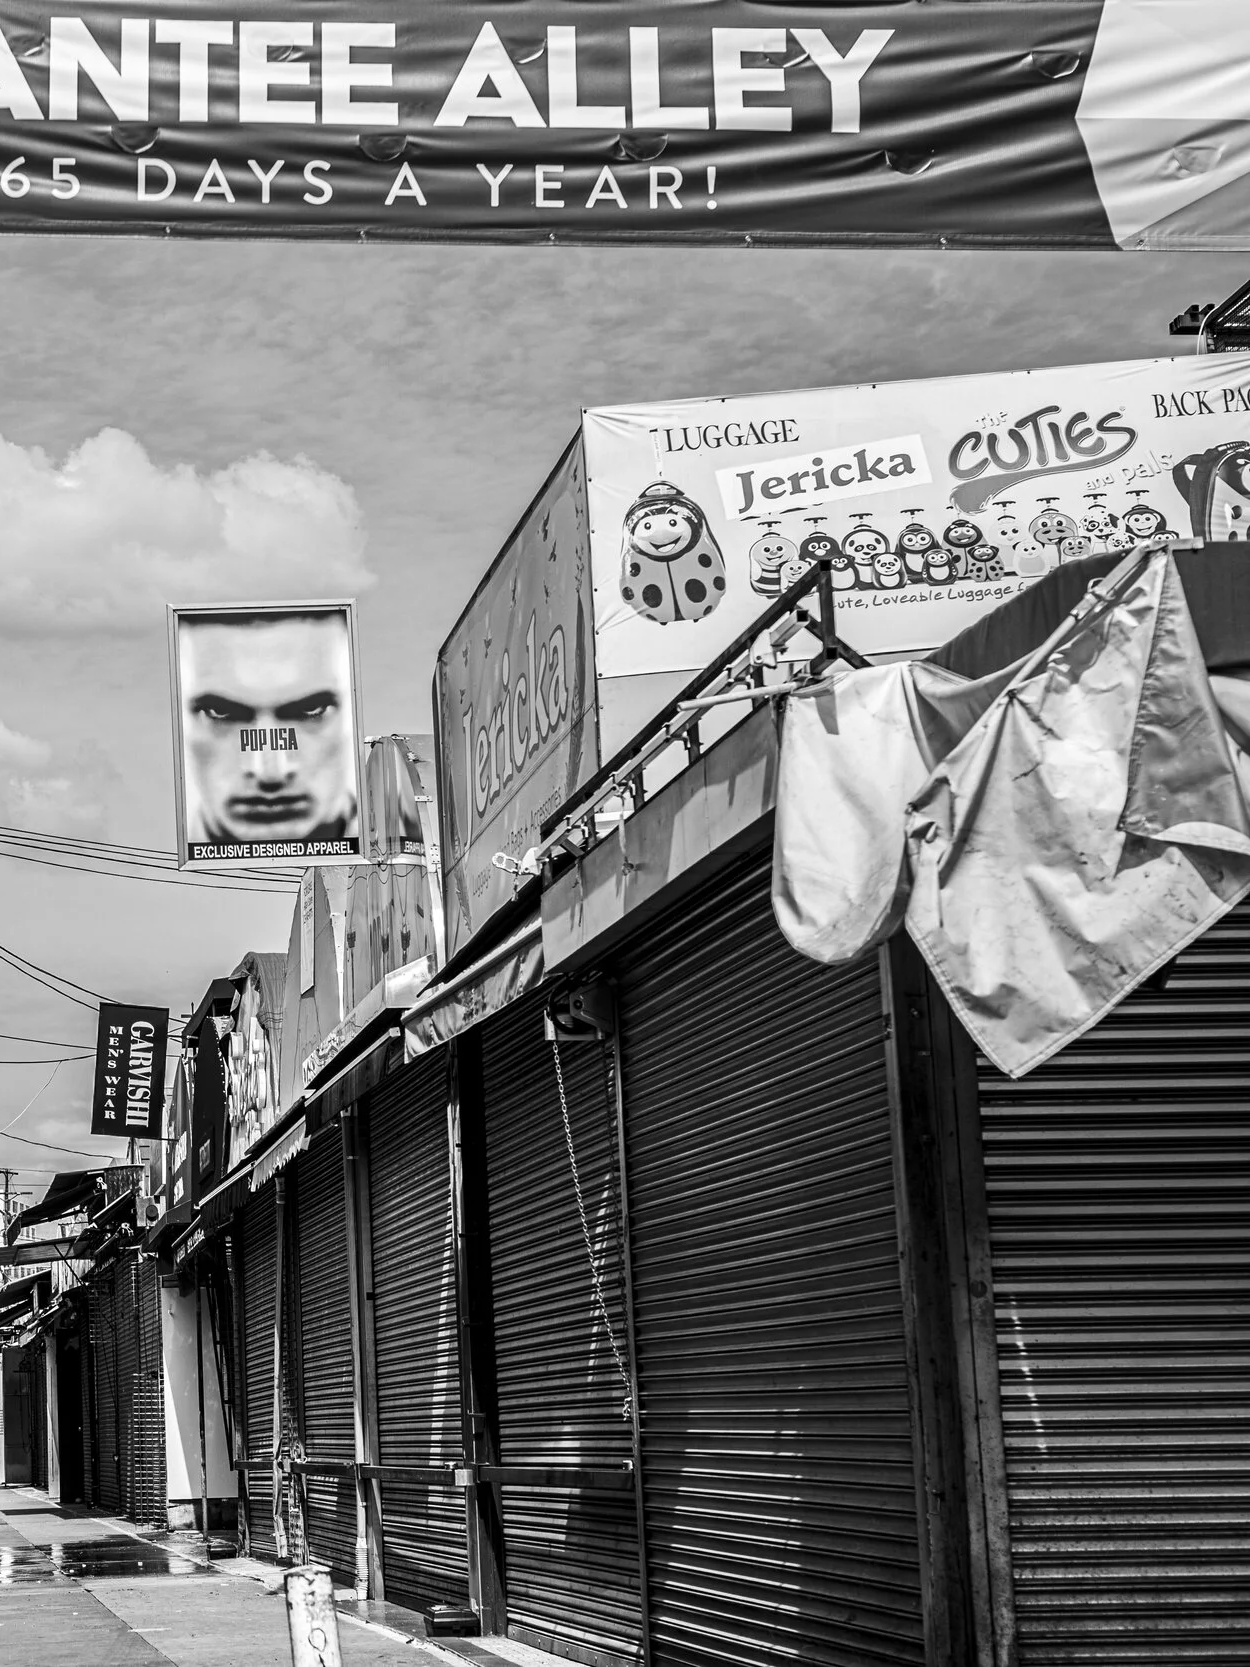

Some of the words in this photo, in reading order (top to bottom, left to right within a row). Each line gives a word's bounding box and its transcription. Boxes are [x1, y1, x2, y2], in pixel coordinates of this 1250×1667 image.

[433, 20, 896, 134] ALLEY
[136, 158, 333, 206] DAYS
[384, 162, 428, 207] A
[476, 163, 720, 210] YEAR!
[976, 410, 1008, 430] The
[1152, 390, 1215, 418] BACK
[1222, 384, 1250, 414] PA
[663, 419, 800, 452] LUGGAGE
[948, 404, 1138, 484] CUTIES
[736, 449, 916, 514] Jericka
[1085, 475, 1114, 491] and
[1120, 451, 1174, 485] pals
[833, 597, 869, 609] ute,
[873, 589, 945, 607] Loveable
[947, 584, 1014, 601] Luggage
[240, 728, 268, 752] POP
[270, 727, 298, 751] USA
[462, 607, 569, 862] Jericka
[194, 844, 250, 858] EXCLUSIVE
[252, 842, 304, 857] DESIGNED
[306, 841, 354, 855] APPAREL
[107, 1026, 124, 1069] MEN'S
[126, 1020, 155, 1127] GARVISHI
[103, 1075, 122, 1120] WEAR
